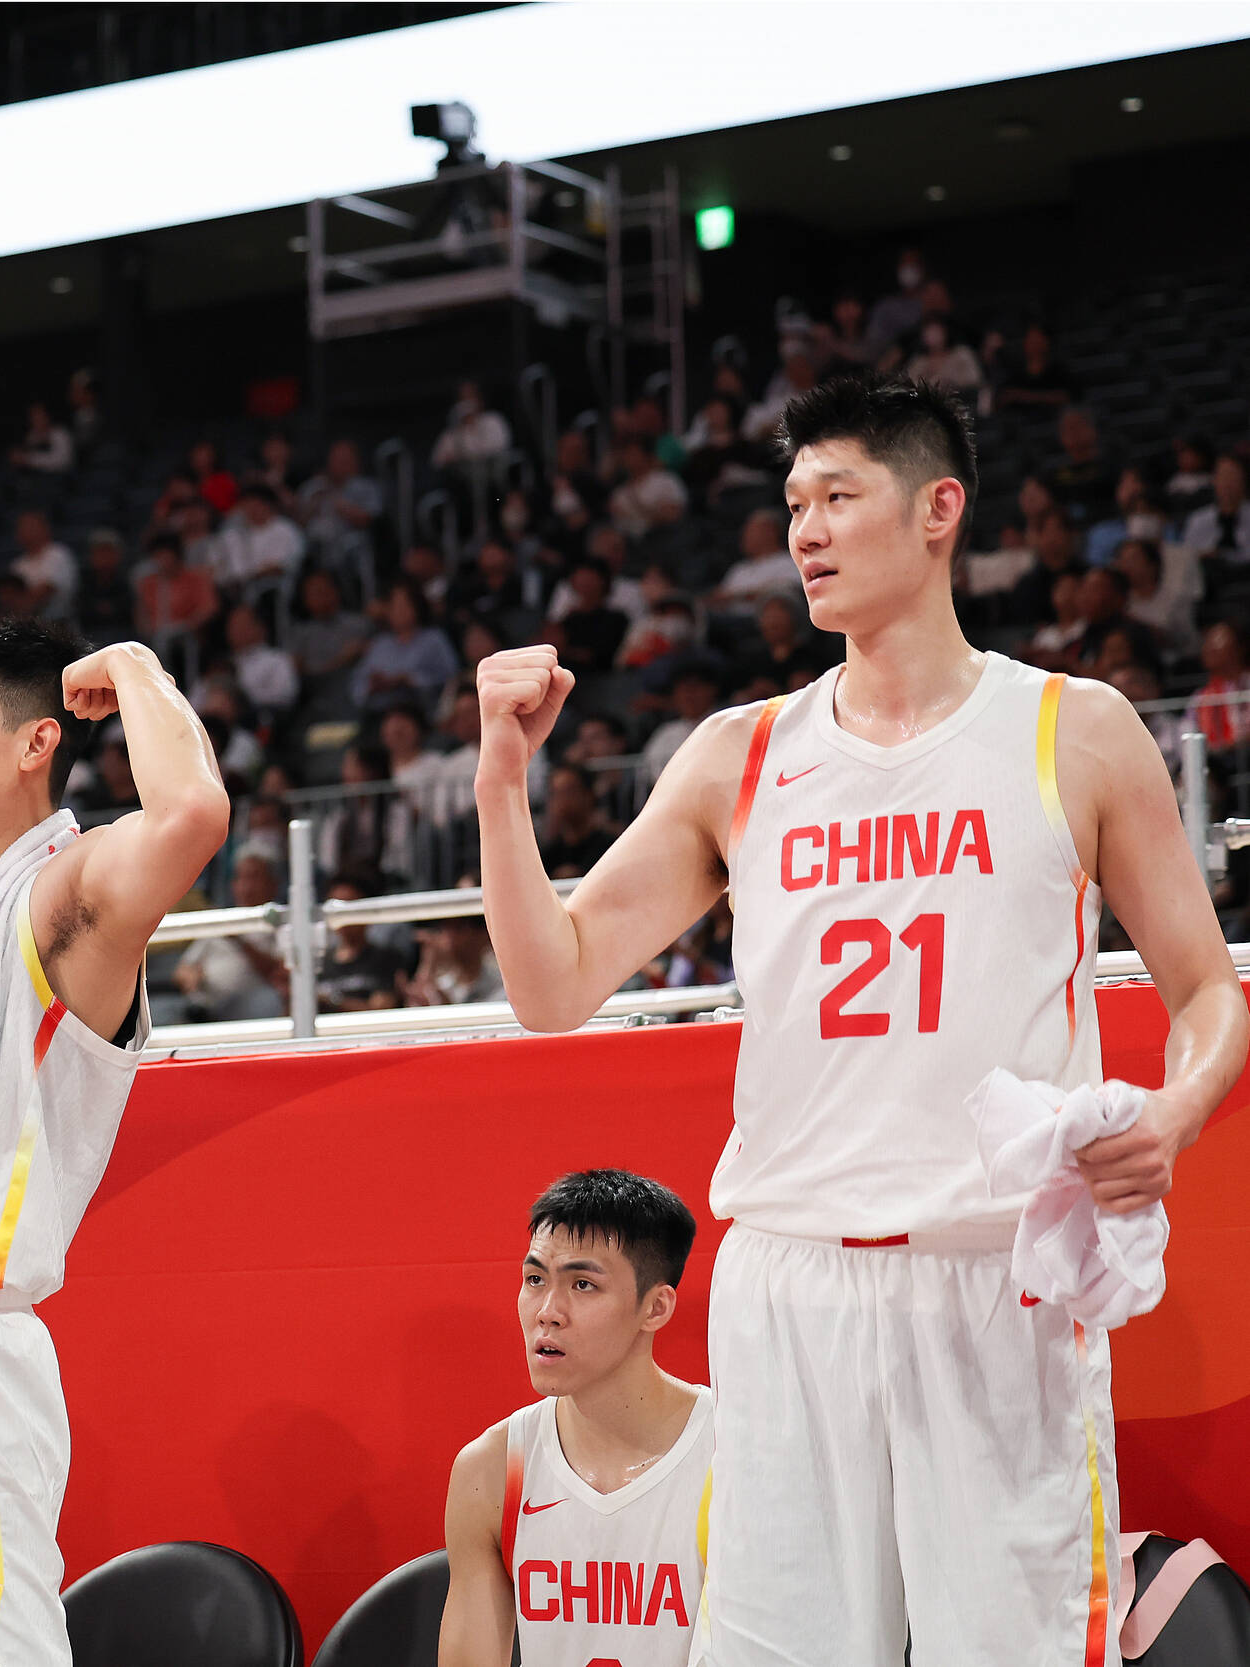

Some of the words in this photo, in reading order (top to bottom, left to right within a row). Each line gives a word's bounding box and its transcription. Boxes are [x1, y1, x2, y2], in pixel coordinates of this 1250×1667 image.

[781, 809, 994, 892] CHINA
[819, 913, 945, 1040] 21
[518, 1559, 690, 1627] CHINA
